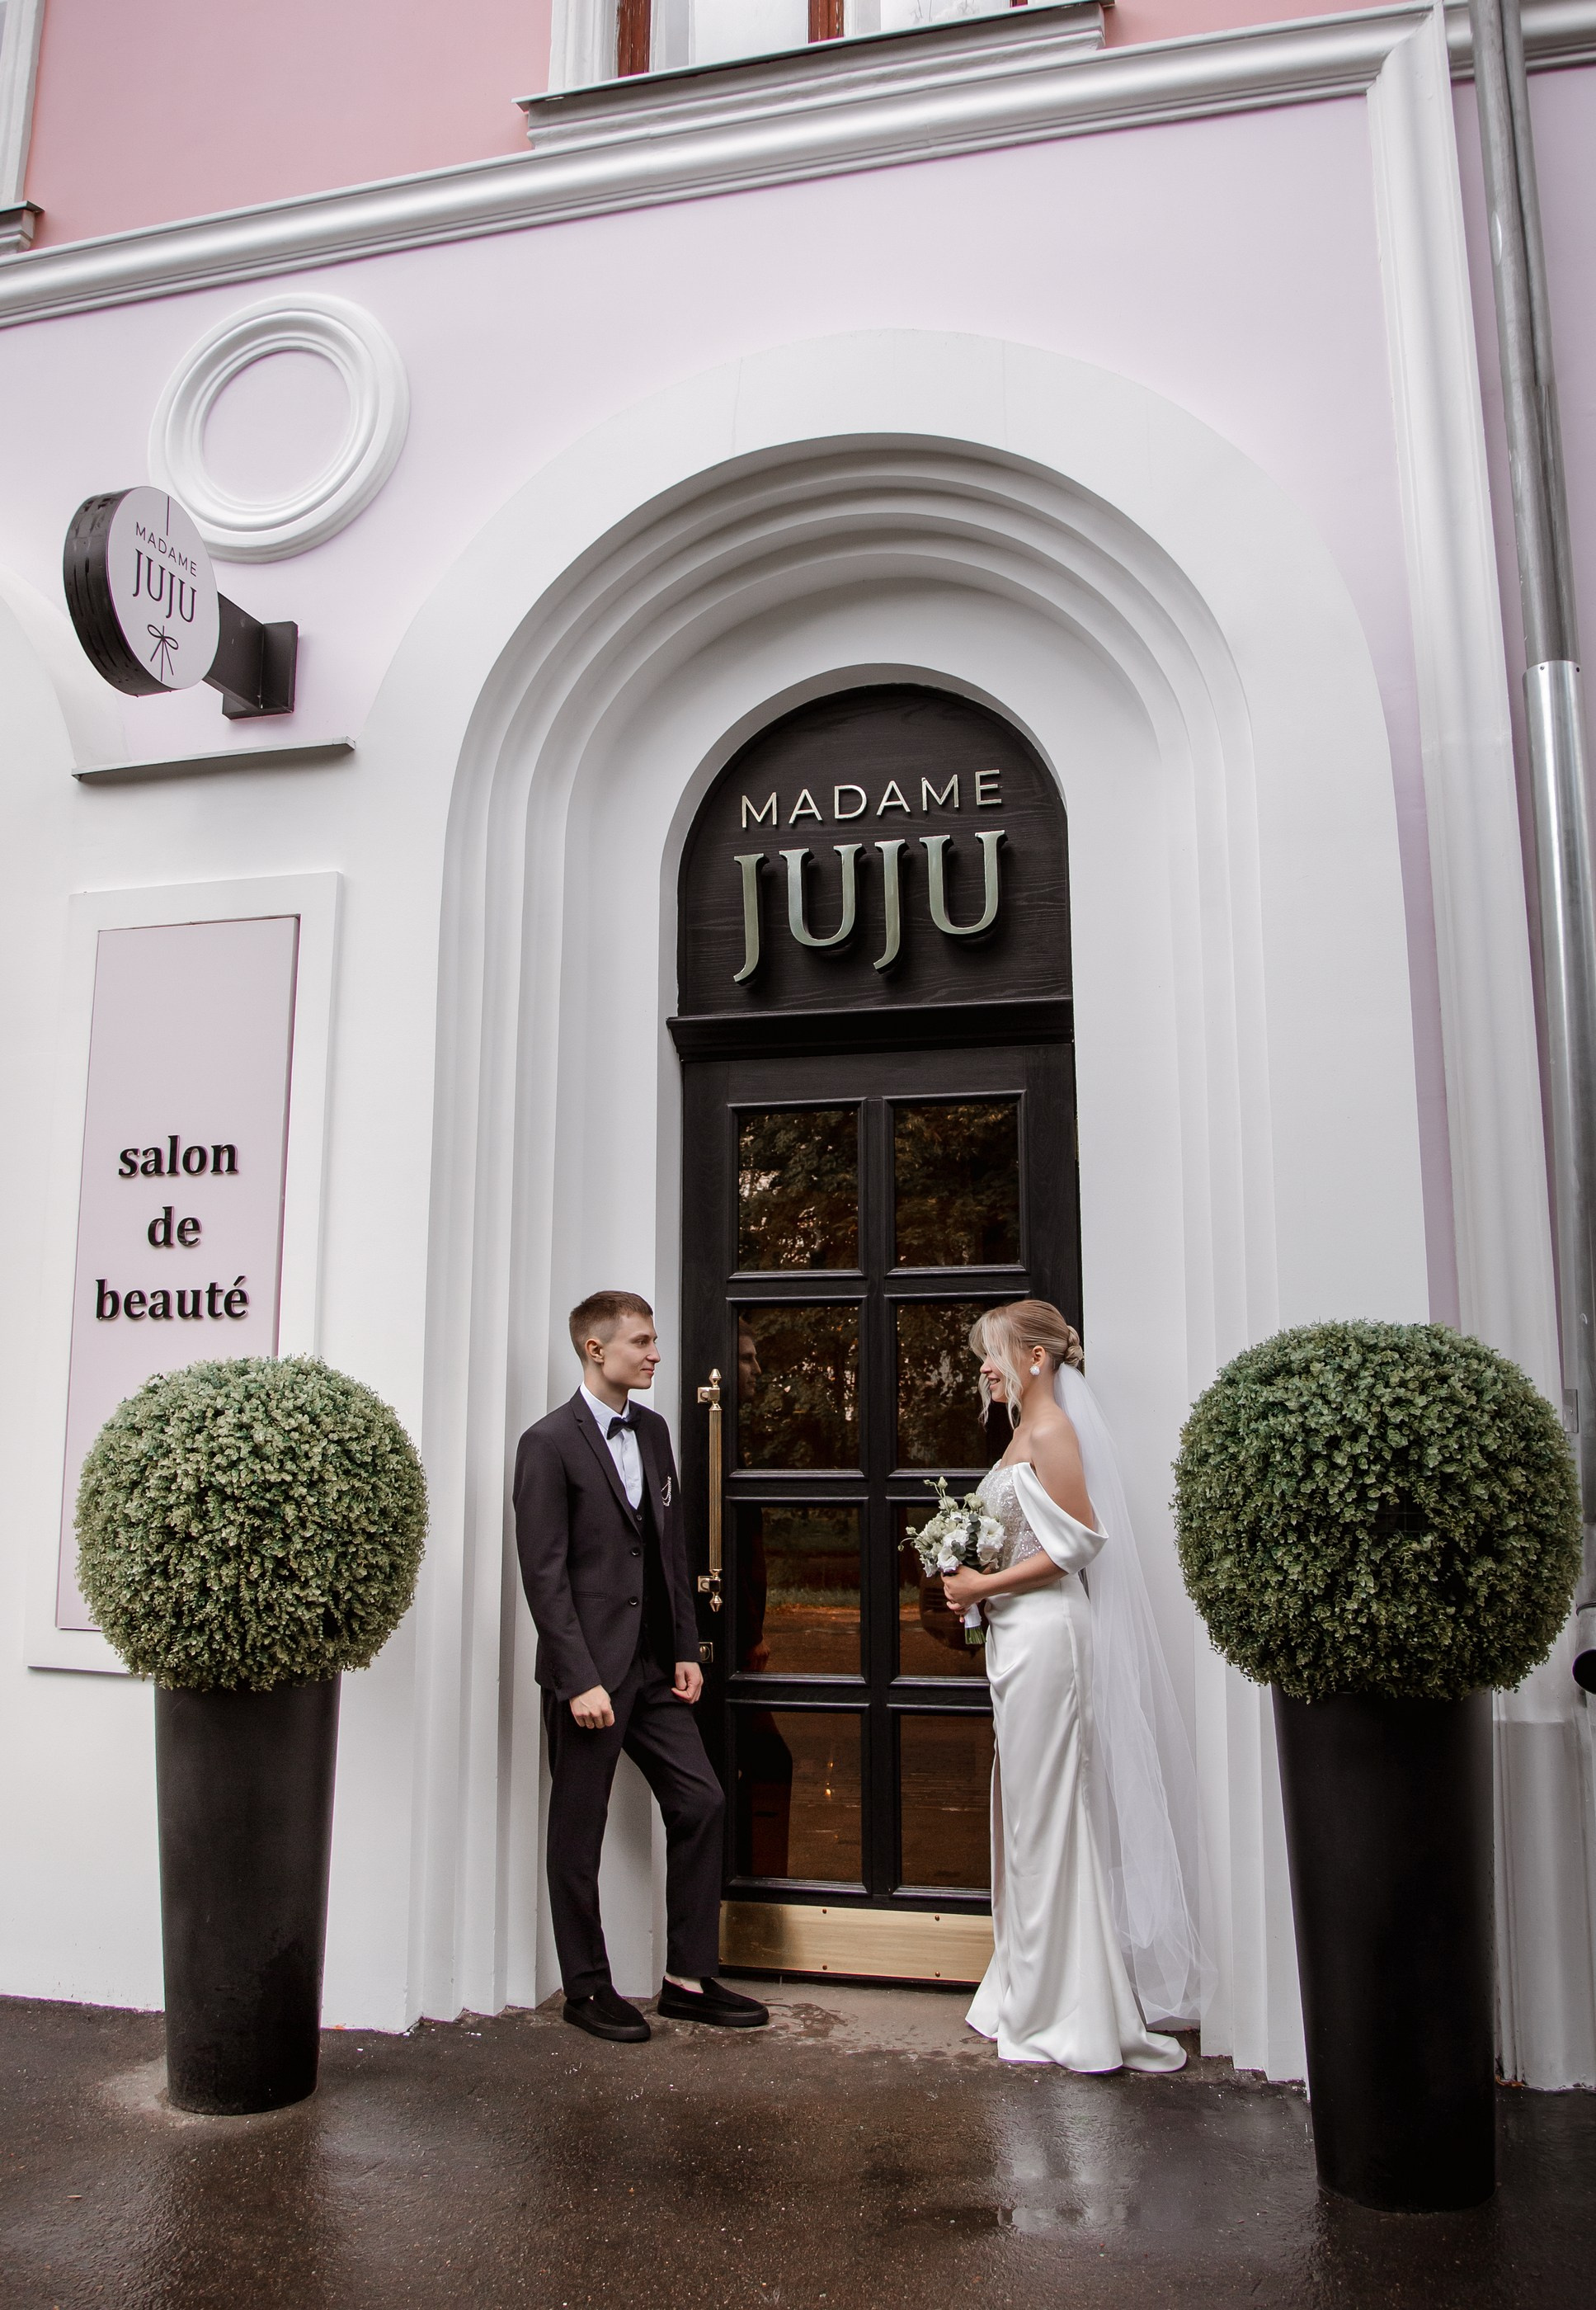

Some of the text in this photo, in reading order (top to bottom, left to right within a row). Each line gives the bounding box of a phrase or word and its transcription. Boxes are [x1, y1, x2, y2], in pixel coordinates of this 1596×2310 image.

[135, 521, 197, 577] MADAME
[132, 548, 197, 623] JUJU
[742, 769, 1002, 828] MADAME
[733, 829, 1007, 985] JUJU
[118, 1134, 238, 1176] salon
[147, 1205, 202, 1247] de
[95, 1275, 249, 1320] beauté
